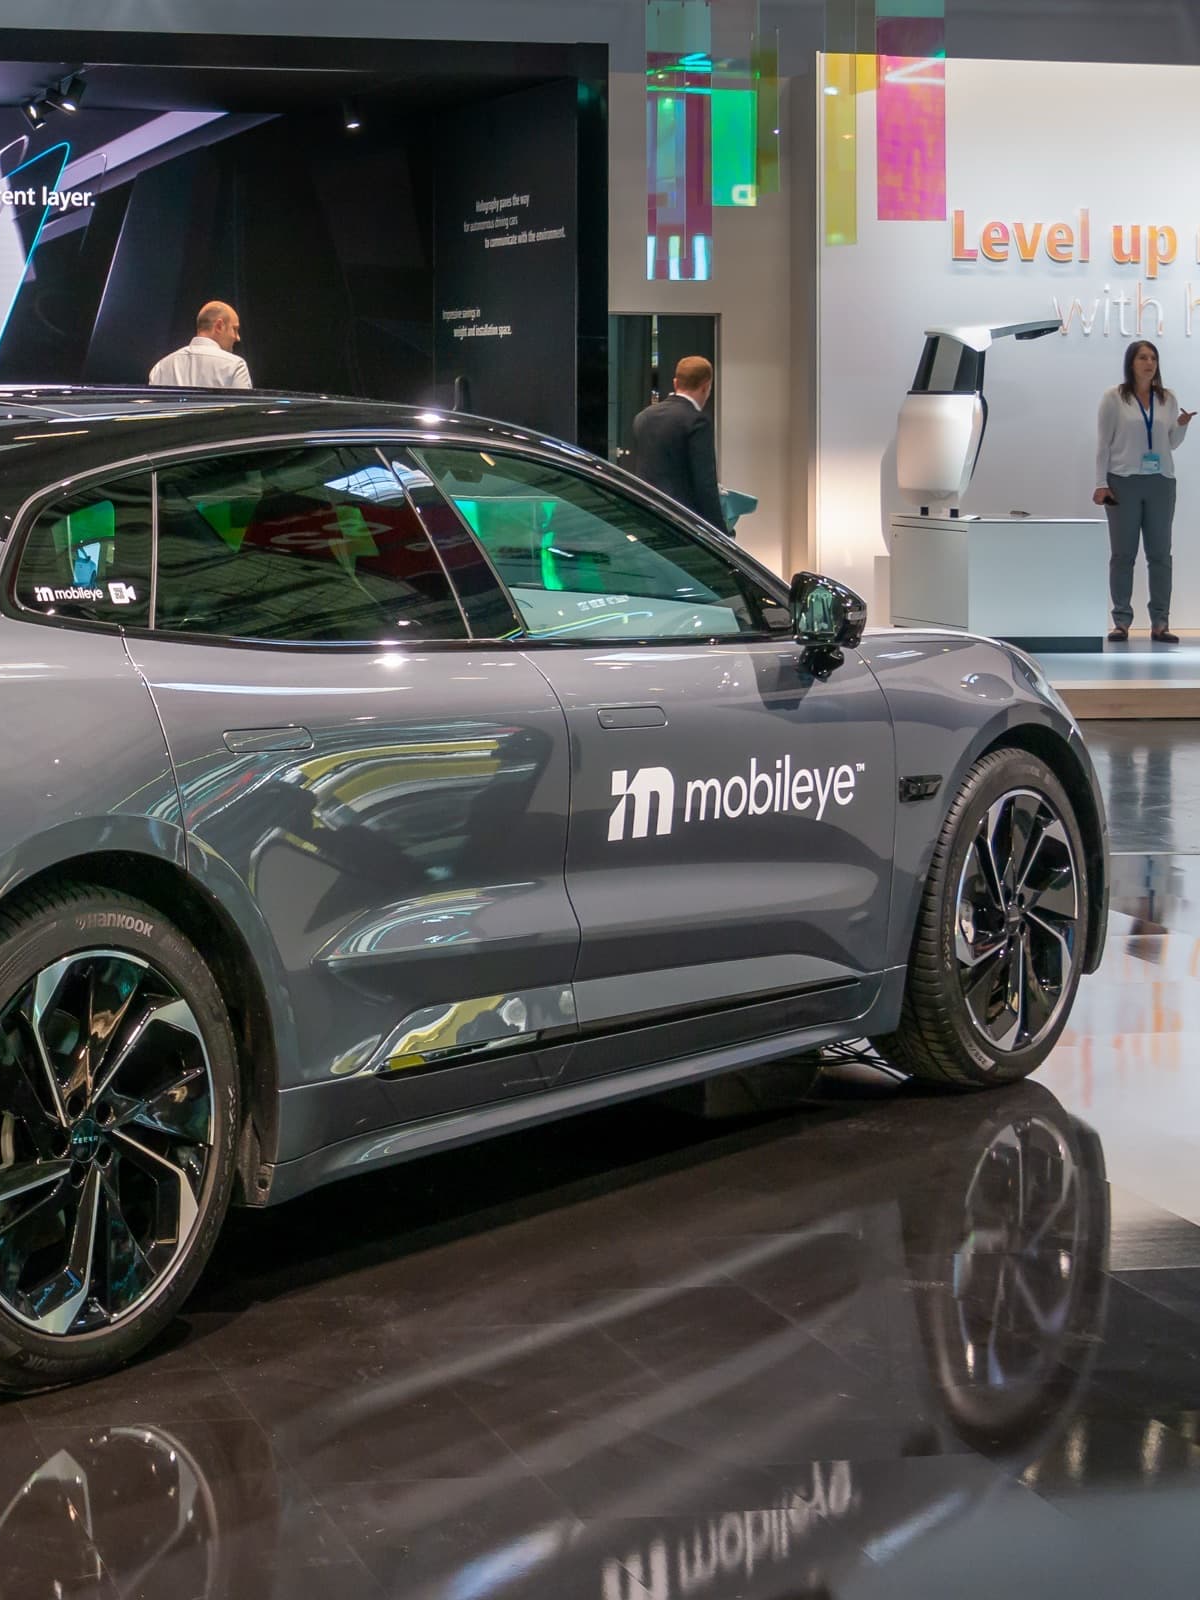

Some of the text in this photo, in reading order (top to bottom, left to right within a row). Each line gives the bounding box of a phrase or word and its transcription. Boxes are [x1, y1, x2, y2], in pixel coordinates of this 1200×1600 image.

[42, 186, 96, 211] layer.
[952, 208, 1090, 263] Level
[1111, 224, 1178, 280] up
[1052, 282, 1164, 337] with
[55, 586, 104, 601] mobileye
